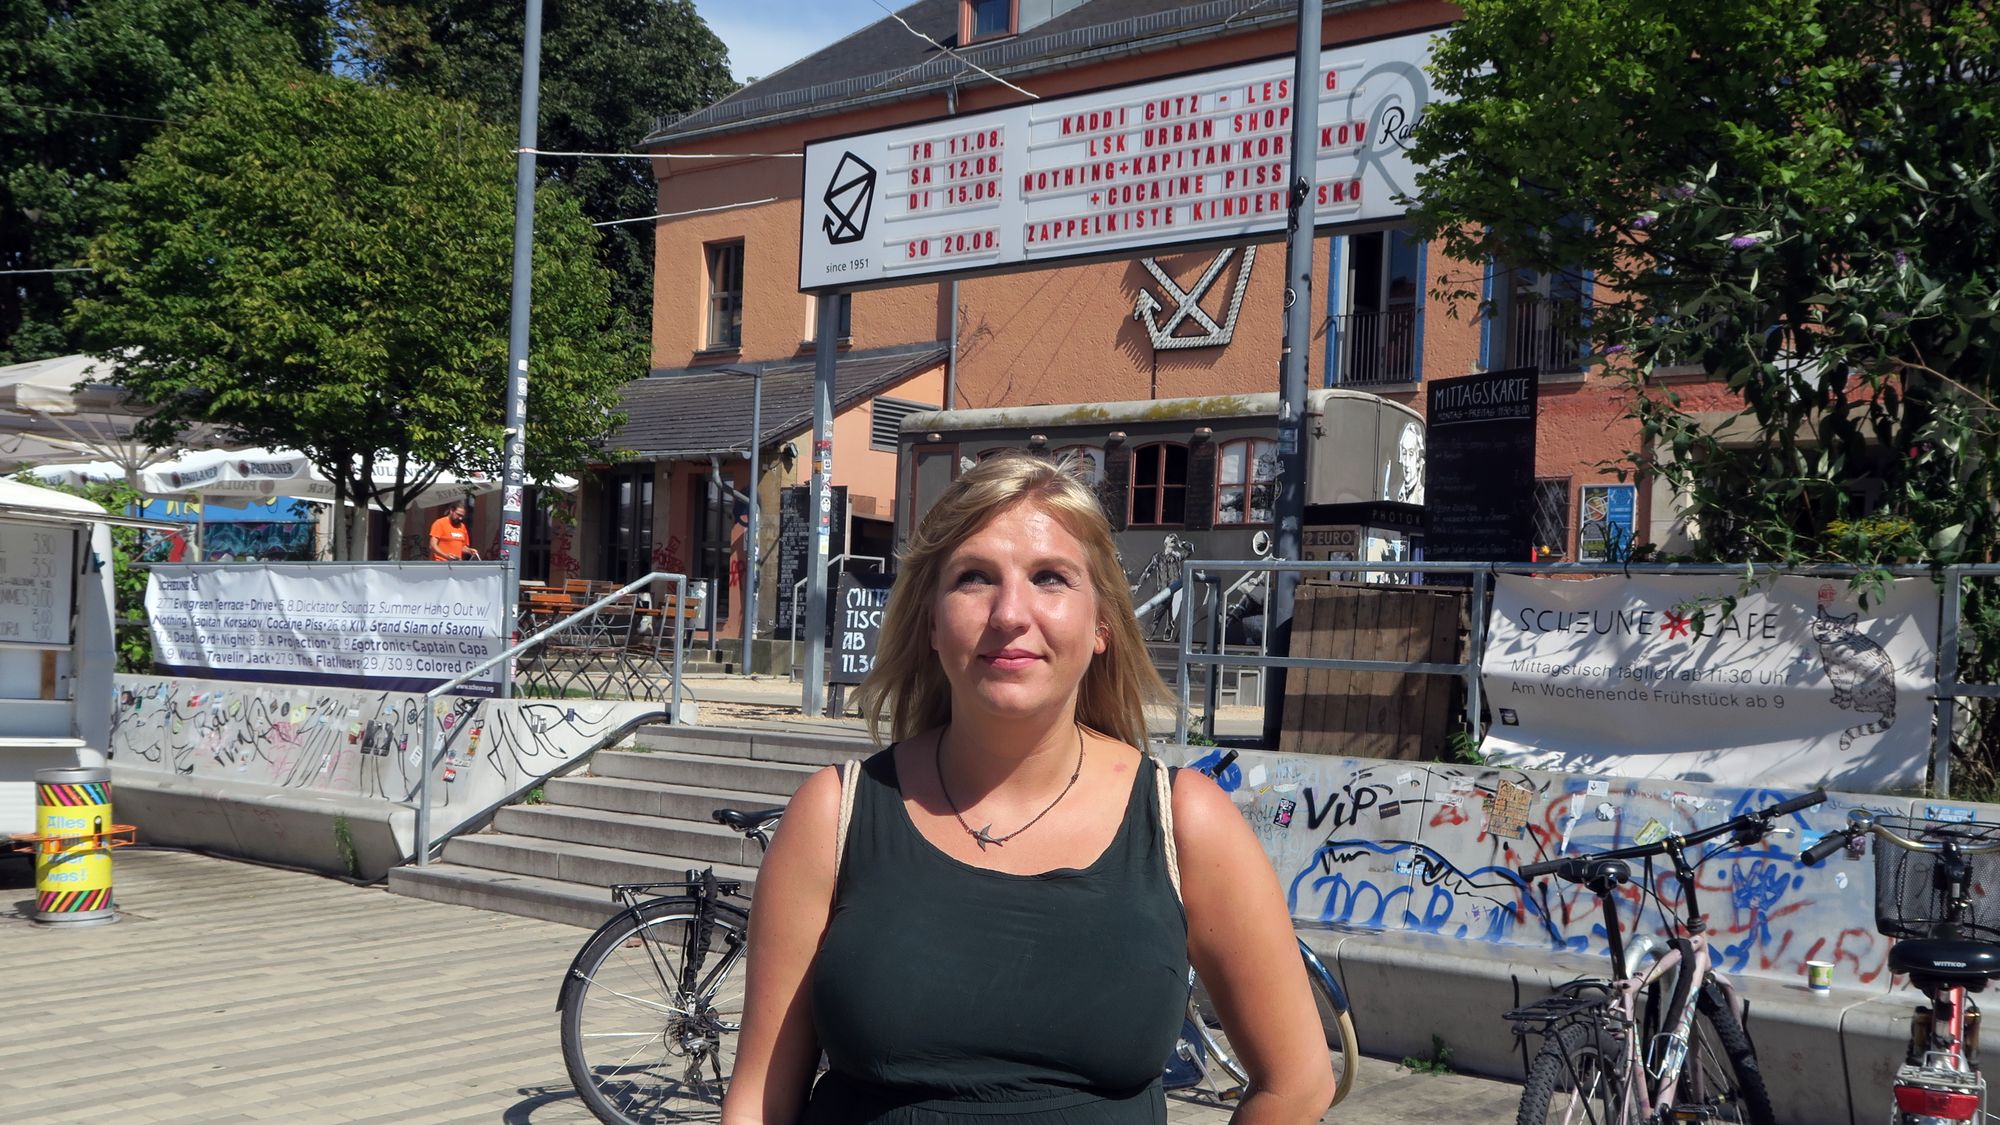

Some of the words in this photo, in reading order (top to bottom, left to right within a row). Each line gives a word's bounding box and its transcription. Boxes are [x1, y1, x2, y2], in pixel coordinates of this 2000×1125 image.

[1062, 107, 1125, 135] KADDI
[1145, 95, 1199, 121] CUTZ
[1247, 70, 1337, 104] LESG
[1090, 134, 1126, 157] LSK
[1144, 119, 1213, 147] URBAN
[1234, 106, 1290, 133] SHOP
[1379, 106, 1424, 150] Rad
[913, 142, 932, 161] FR
[949, 130, 1004, 154] 11.08.
[911, 167, 931, 185] SA
[949, 155, 1003, 180] 12.08.
[1225, 163, 1281, 189] PISS
[909, 191, 928, 209] DI
[948, 180, 1002, 204] 15.08.
[1027, 207, 1174, 243] ZAPPELKISTE
[1193, 180, 1361, 221] KINDERSKO
[909, 239, 928, 258] SO
[944, 230, 999, 254] 20.08.
[826, 262, 847, 274] since
[850, 258, 869, 271] 1951
[1435, 378, 1529, 411] MITTAGSKARTE
[181, 466, 219, 484] PAULANER
[250, 462, 294, 475] PAULANER
[1303, 532, 1313, 545] 2
[1317, 531, 1352, 545] EURO
[342, 600, 376, 614] Soundz
[379, 601, 421, 615] Summer
[423, 602, 450, 617] Hang
[453, 602, 473, 616] Out
[476, 602, 492, 617] w/
[846, 610, 885, 629] TISC
[370, 620, 401, 633] Grand
[403, 620, 428, 634] Slam
[431, 621, 444, 635] of
[445, 622, 485, 639] Saxony
[1519, 608, 1655, 636] SCHEUNE
[1697, 612, 1778, 640] CAFE
[459, 642, 488, 657] Capa
[842, 631, 866, 650] AB
[1511, 659, 1612, 677] Mittagstisch
[1619, 666, 1674, 681] täglich
[1681, 668, 1701, 682] ab
[1709, 668, 1753, 684] 11:30
[1759, 670, 1792, 686] Uhr
[1511, 681, 1536, 695] Am
[1540, 683, 1649, 701] Wochenende
[1653, 689, 1739, 707] Frühstück
[1746, 693, 1768, 709] ab
[1773, 695, 1785, 709] 9
[47, 815, 86, 829] Alles
[48, 868, 87, 882] was!
[1933, 960, 1967, 969] WITTKOP
